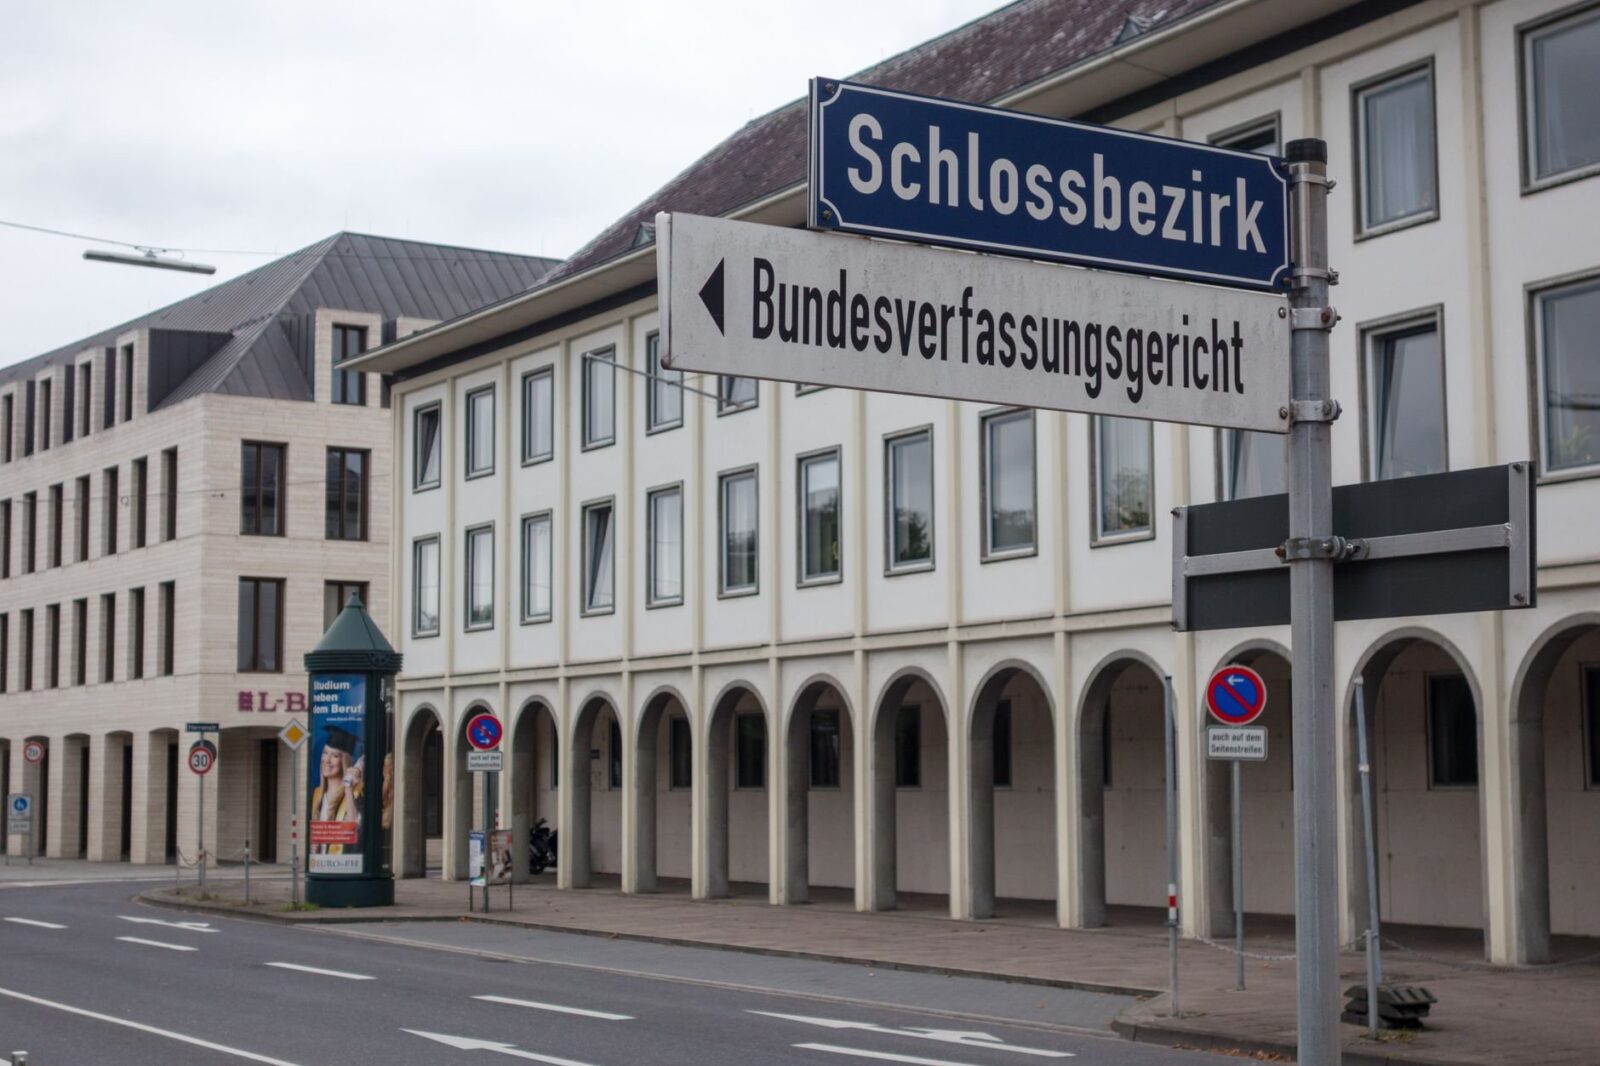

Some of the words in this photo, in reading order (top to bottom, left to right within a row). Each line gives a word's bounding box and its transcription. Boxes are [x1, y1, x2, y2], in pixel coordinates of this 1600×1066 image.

[847, 113, 1267, 254] Schlossbezirk
[752, 257, 1244, 403] Bundesverfassungsgericht
[258, 692, 308, 712] L-B
[331, 704, 361, 713] Beruf
[1212, 732, 1229, 741] auch
[1232, 732, 1244, 741] auf
[1246, 732, 1262, 741] dem
[1211, 743, 1263, 753] Seitenstreifen
[193, 754, 208, 768] 30
